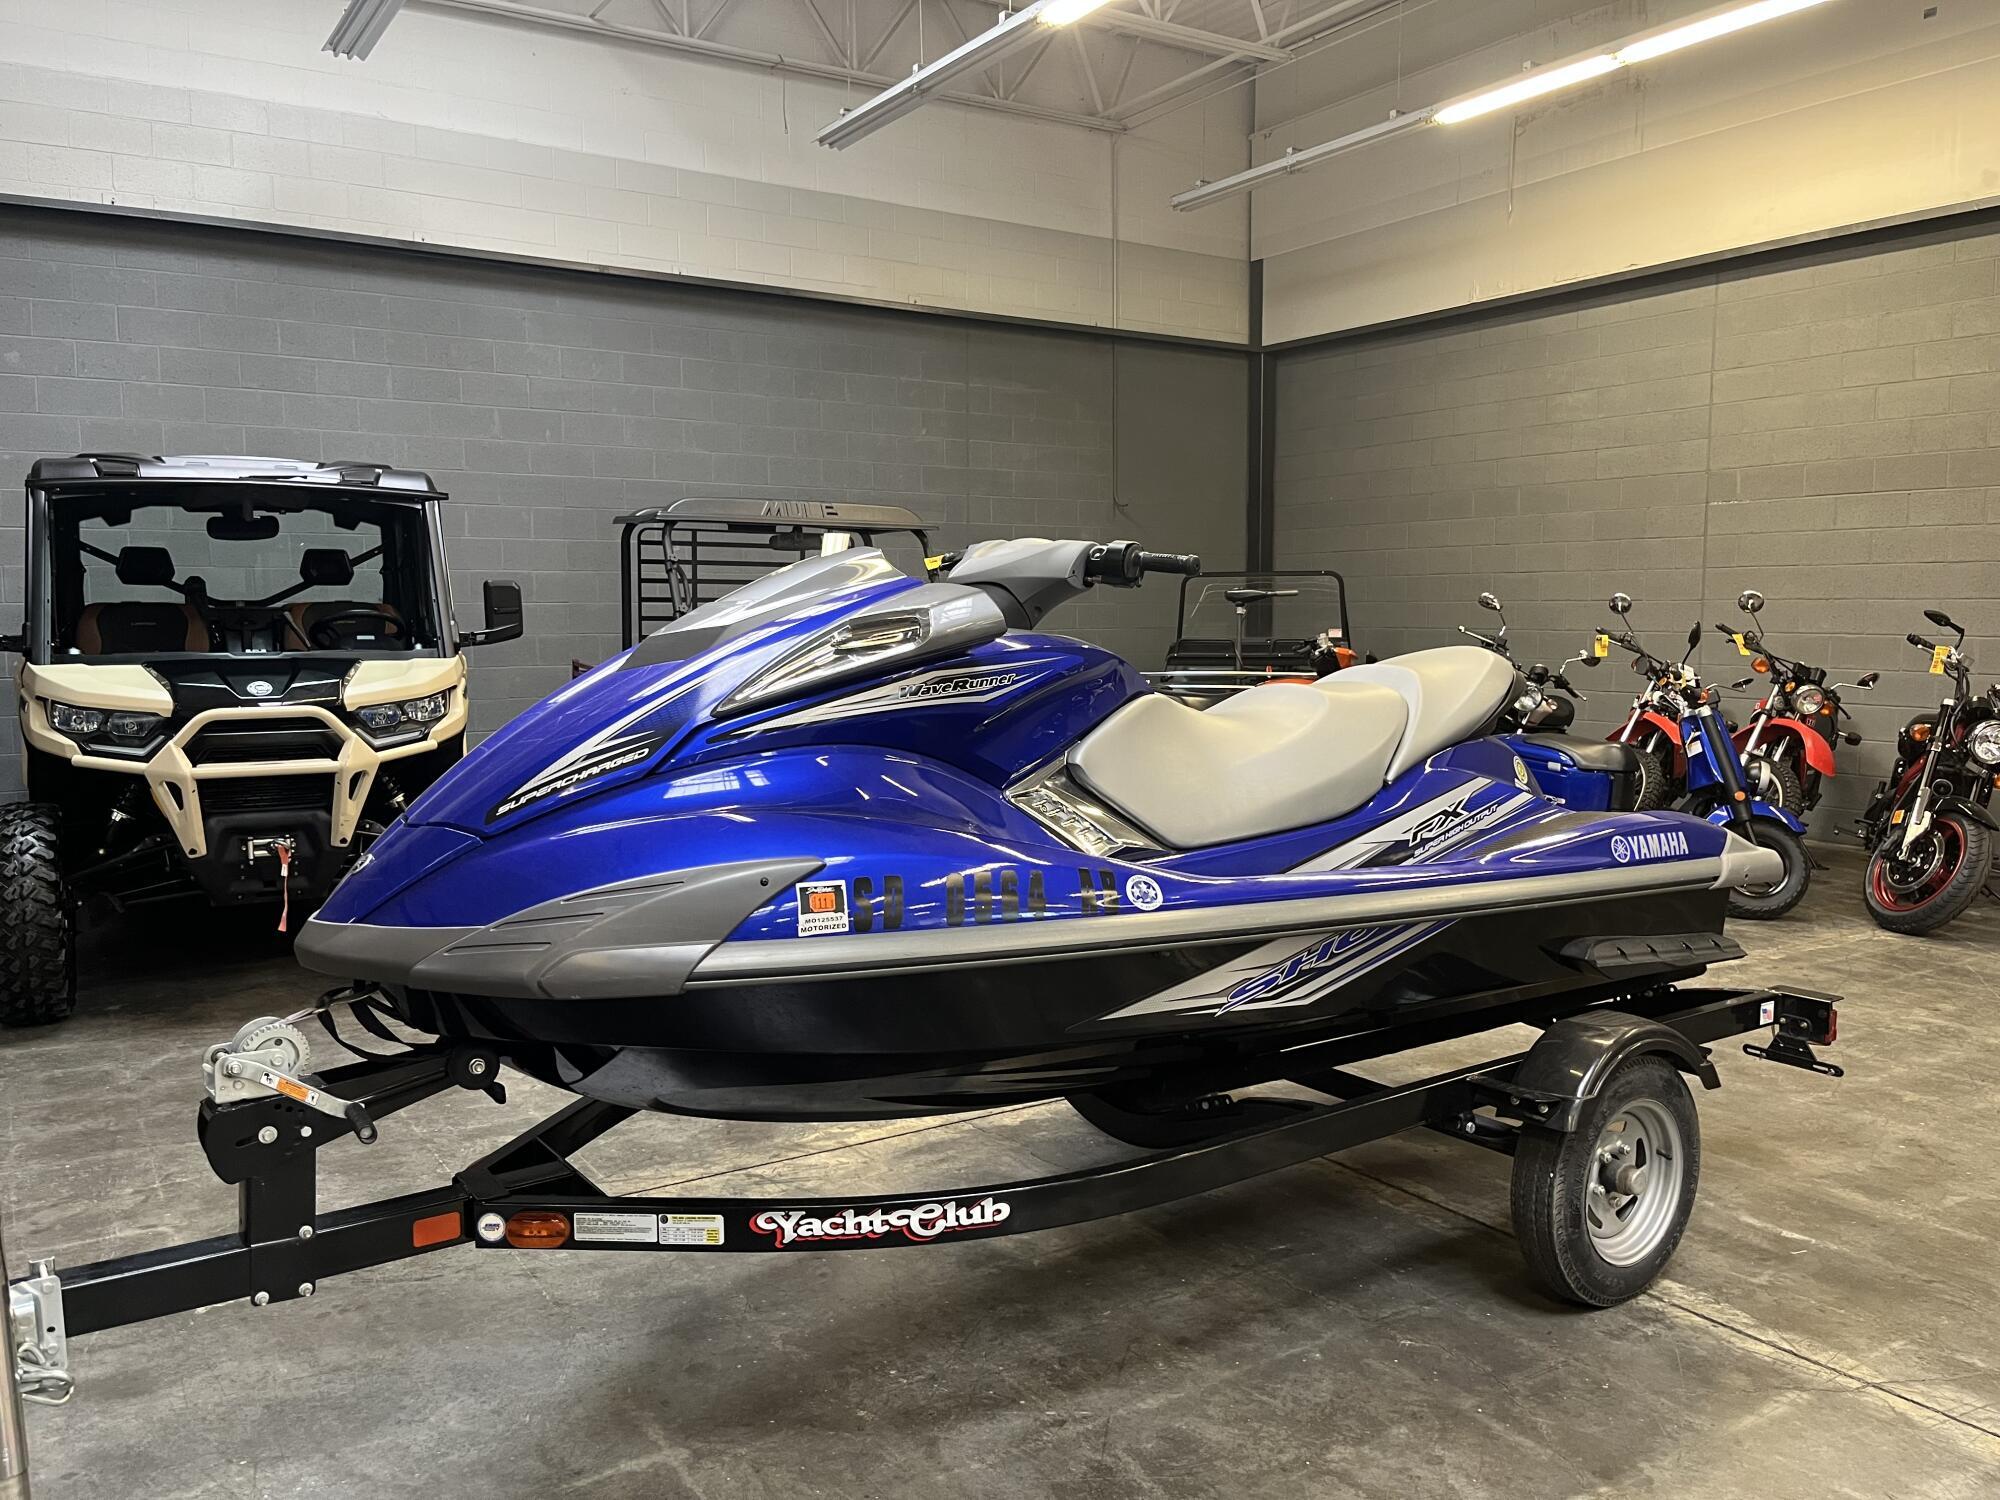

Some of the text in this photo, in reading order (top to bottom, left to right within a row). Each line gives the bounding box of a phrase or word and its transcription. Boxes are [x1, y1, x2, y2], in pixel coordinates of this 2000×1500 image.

[899, 673, 1016, 699] WaveRunner
[496, 748, 649, 816] SUPERCHARGED
[1413, 803, 1499, 858] SUPER HIGH OUTPUT
[1627, 831, 1689, 859] YAMAHA
[800, 923, 847, 933] MOTORIZED
